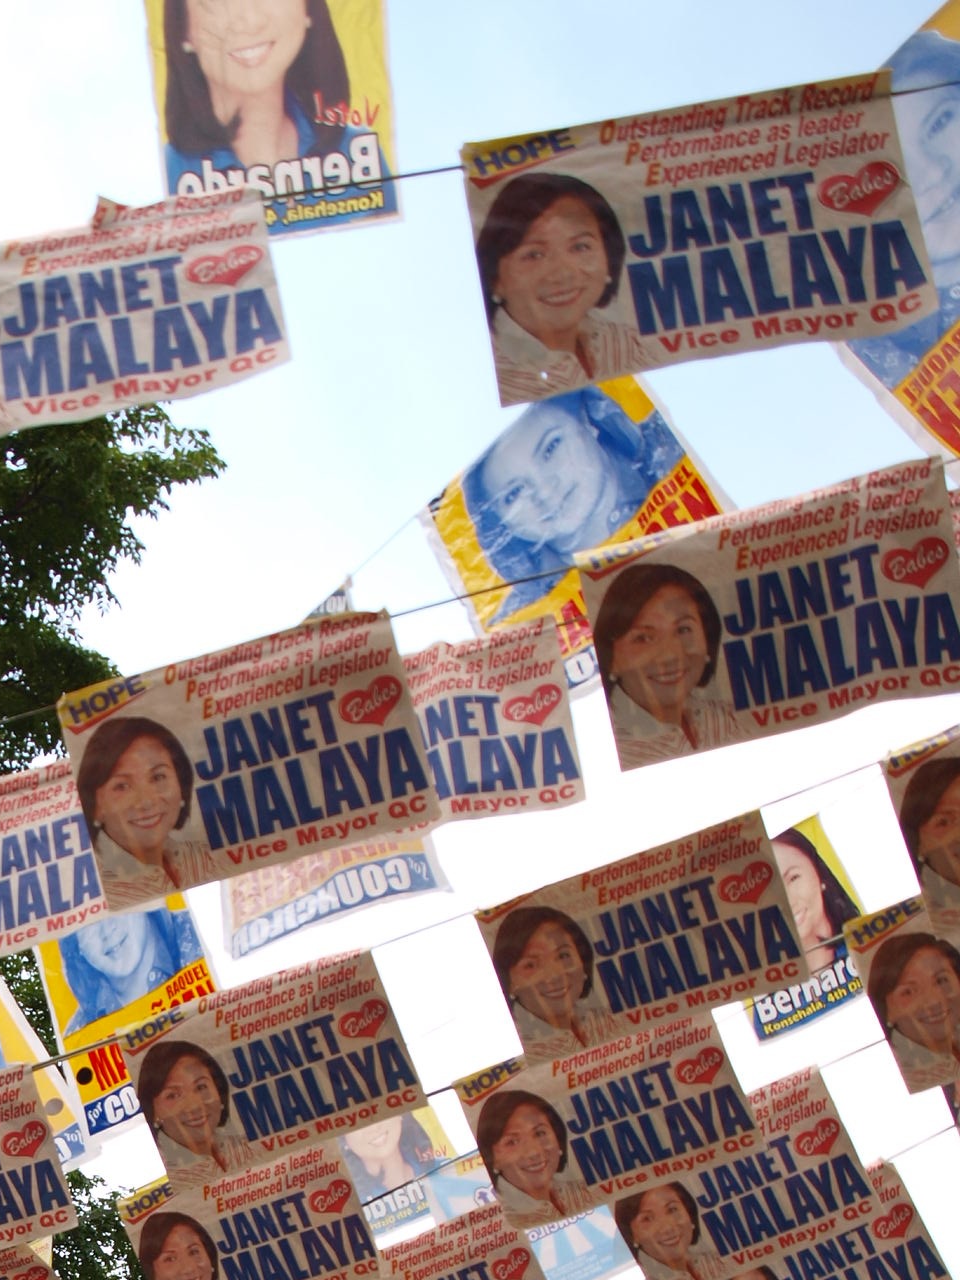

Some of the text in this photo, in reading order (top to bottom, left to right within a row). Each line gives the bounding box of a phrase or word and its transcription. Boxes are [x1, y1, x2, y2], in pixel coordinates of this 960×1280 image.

[598, 74, 879, 145] Outstanding Track Record
[625, 108, 865, 166] Performance as leader
[473, 129, 577, 176] HOPE
[645, 130, 891, 187] Experienced Legislator
[627, 169, 894, 259] JANET Babes
[3, 254, 184, 340] JANET
[626, 219, 928, 338] MALAYA
[658, 293, 923, 355] Vice Mayor QC
[637, 465, 695, 530] RAQUEL
[735, 509, 946, 571] Experienced Legislator
[722, 542, 948, 638] JANET Babes
[721, 592, 960, 713] MALAYA
[68, 675, 148, 725] HOPE
[196, 681, 399, 782] JANET Babes
[751, 665, 960, 728] Vice Mayor QC
[194, 727, 428, 852] MALAYA
[226, 796, 428, 866] Vice Mayor QC
[594, 876, 720, 958] JANET
[850, 898, 923, 946] HOPE
[165, 963, 208, 1001] RAQUEL
[595, 904, 801, 1013] MALAYA
[124, 1007, 184, 1048] HOPE
[625, 962, 800, 1026] Vice Mayor QC
[764, 989, 847, 1035] Konsehala, 4th
[229, 1014, 337, 1089] JANET
[230, 1037, 418, 1142] MALAYA
[565, 1061, 676, 1135] JANET
[568, 1083, 757, 1186] MALAYA
[696, 1134, 795, 1210] JANET
[699, 1153, 872, 1256] MALAYA
[39, 1209, 69, 1228] QC
[216, 1192, 312, 1255] JANET
